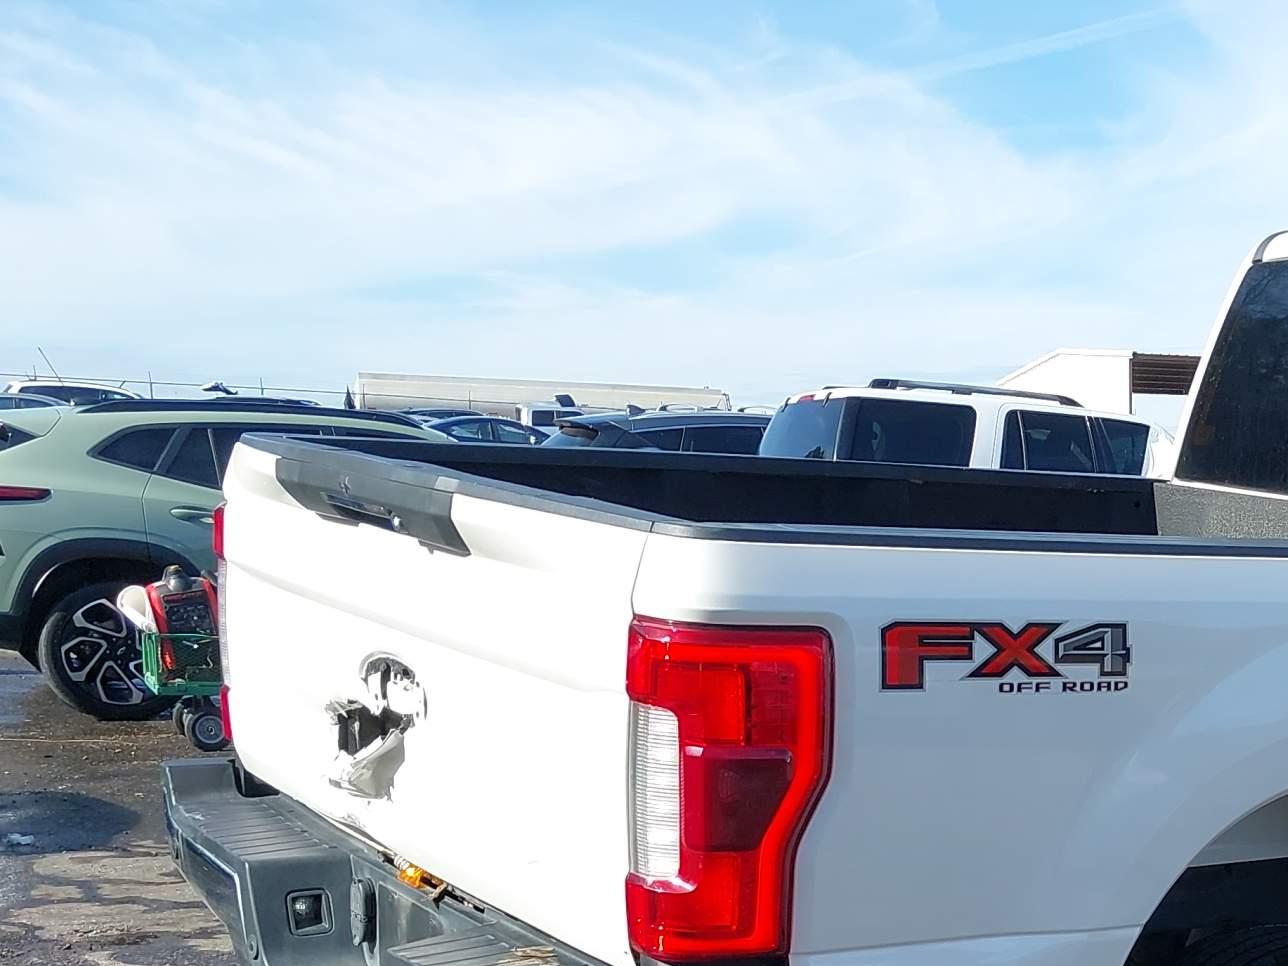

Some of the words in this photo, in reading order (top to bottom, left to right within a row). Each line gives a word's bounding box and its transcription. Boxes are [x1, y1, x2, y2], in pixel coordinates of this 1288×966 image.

[879, 620, 1132, 690] FX4
[999, 681, 1051, 693] OFF
[1062, 680, 1128, 692] ROAD
